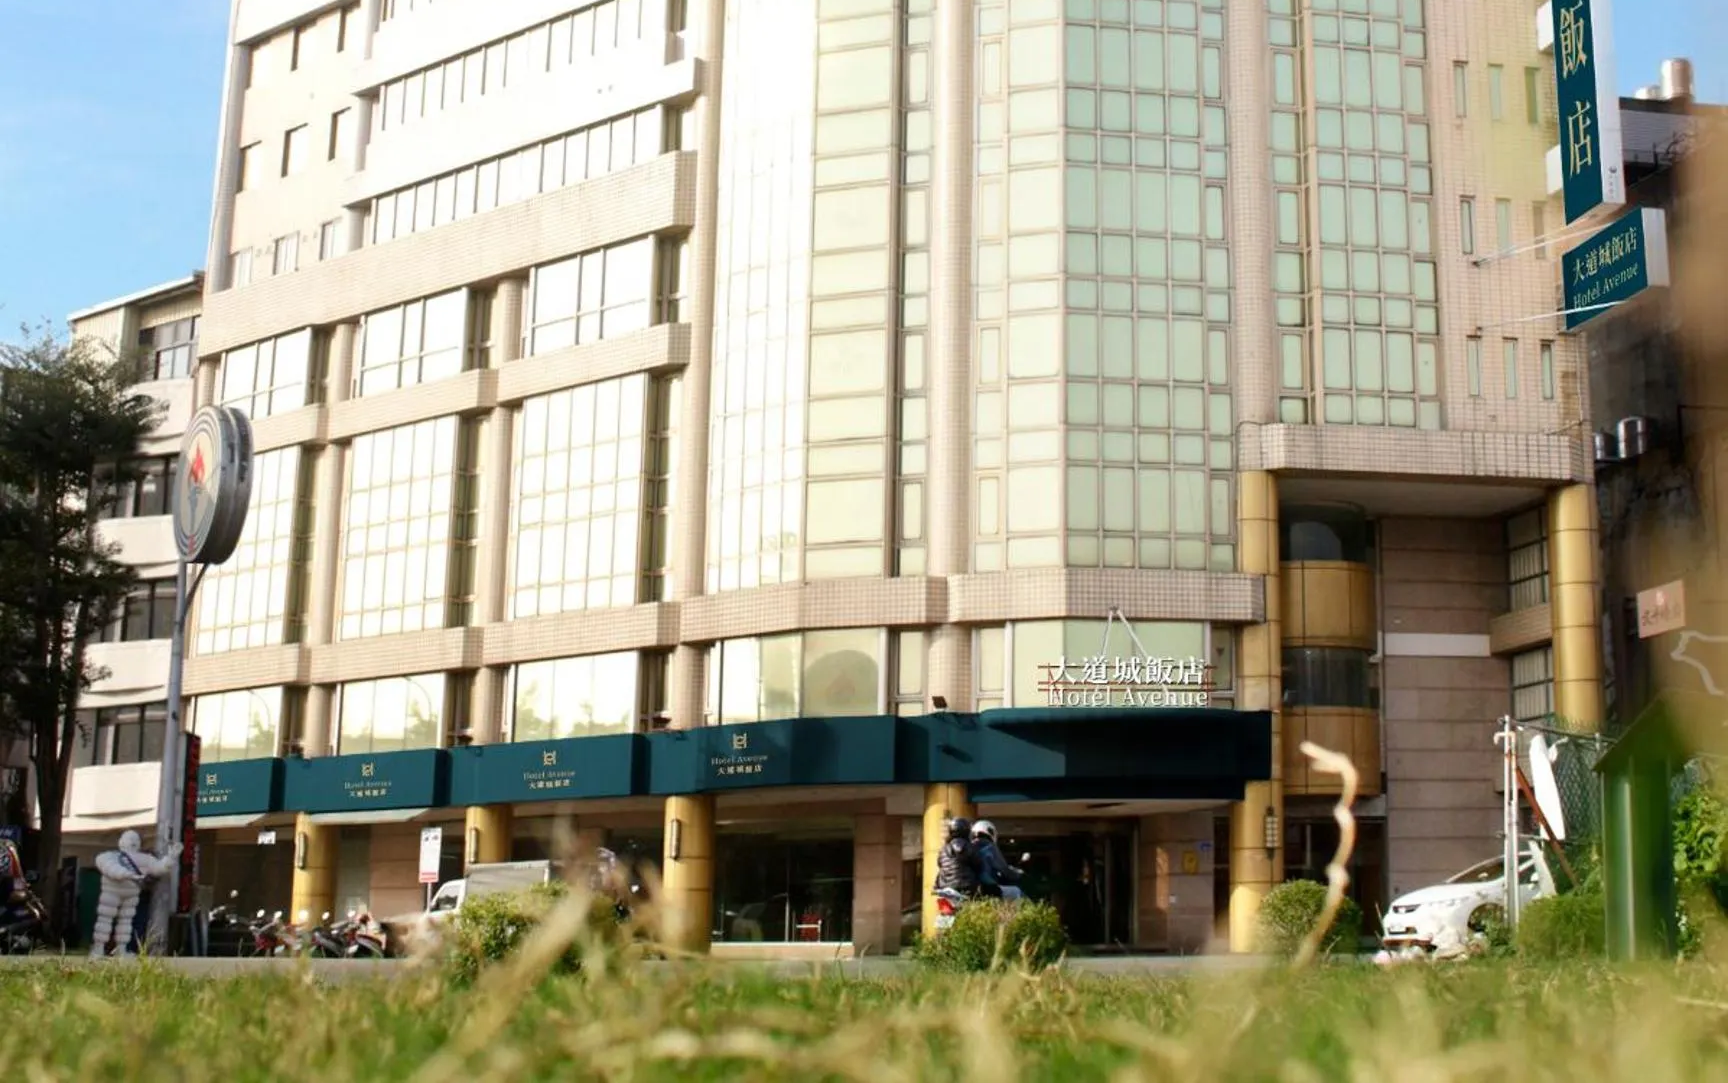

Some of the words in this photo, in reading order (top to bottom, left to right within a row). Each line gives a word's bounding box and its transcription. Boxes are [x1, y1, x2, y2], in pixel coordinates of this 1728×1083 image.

[1573, 226, 1638, 287] 大道城飯店
[1573, 281, 1600, 309] Hotel
[1603, 262, 1639, 295] Avenue
[1050, 654, 1208, 685] 大道城飯店
[1049, 684, 1112, 707] Hotel
[1121, 686, 1209, 707] Avenue
